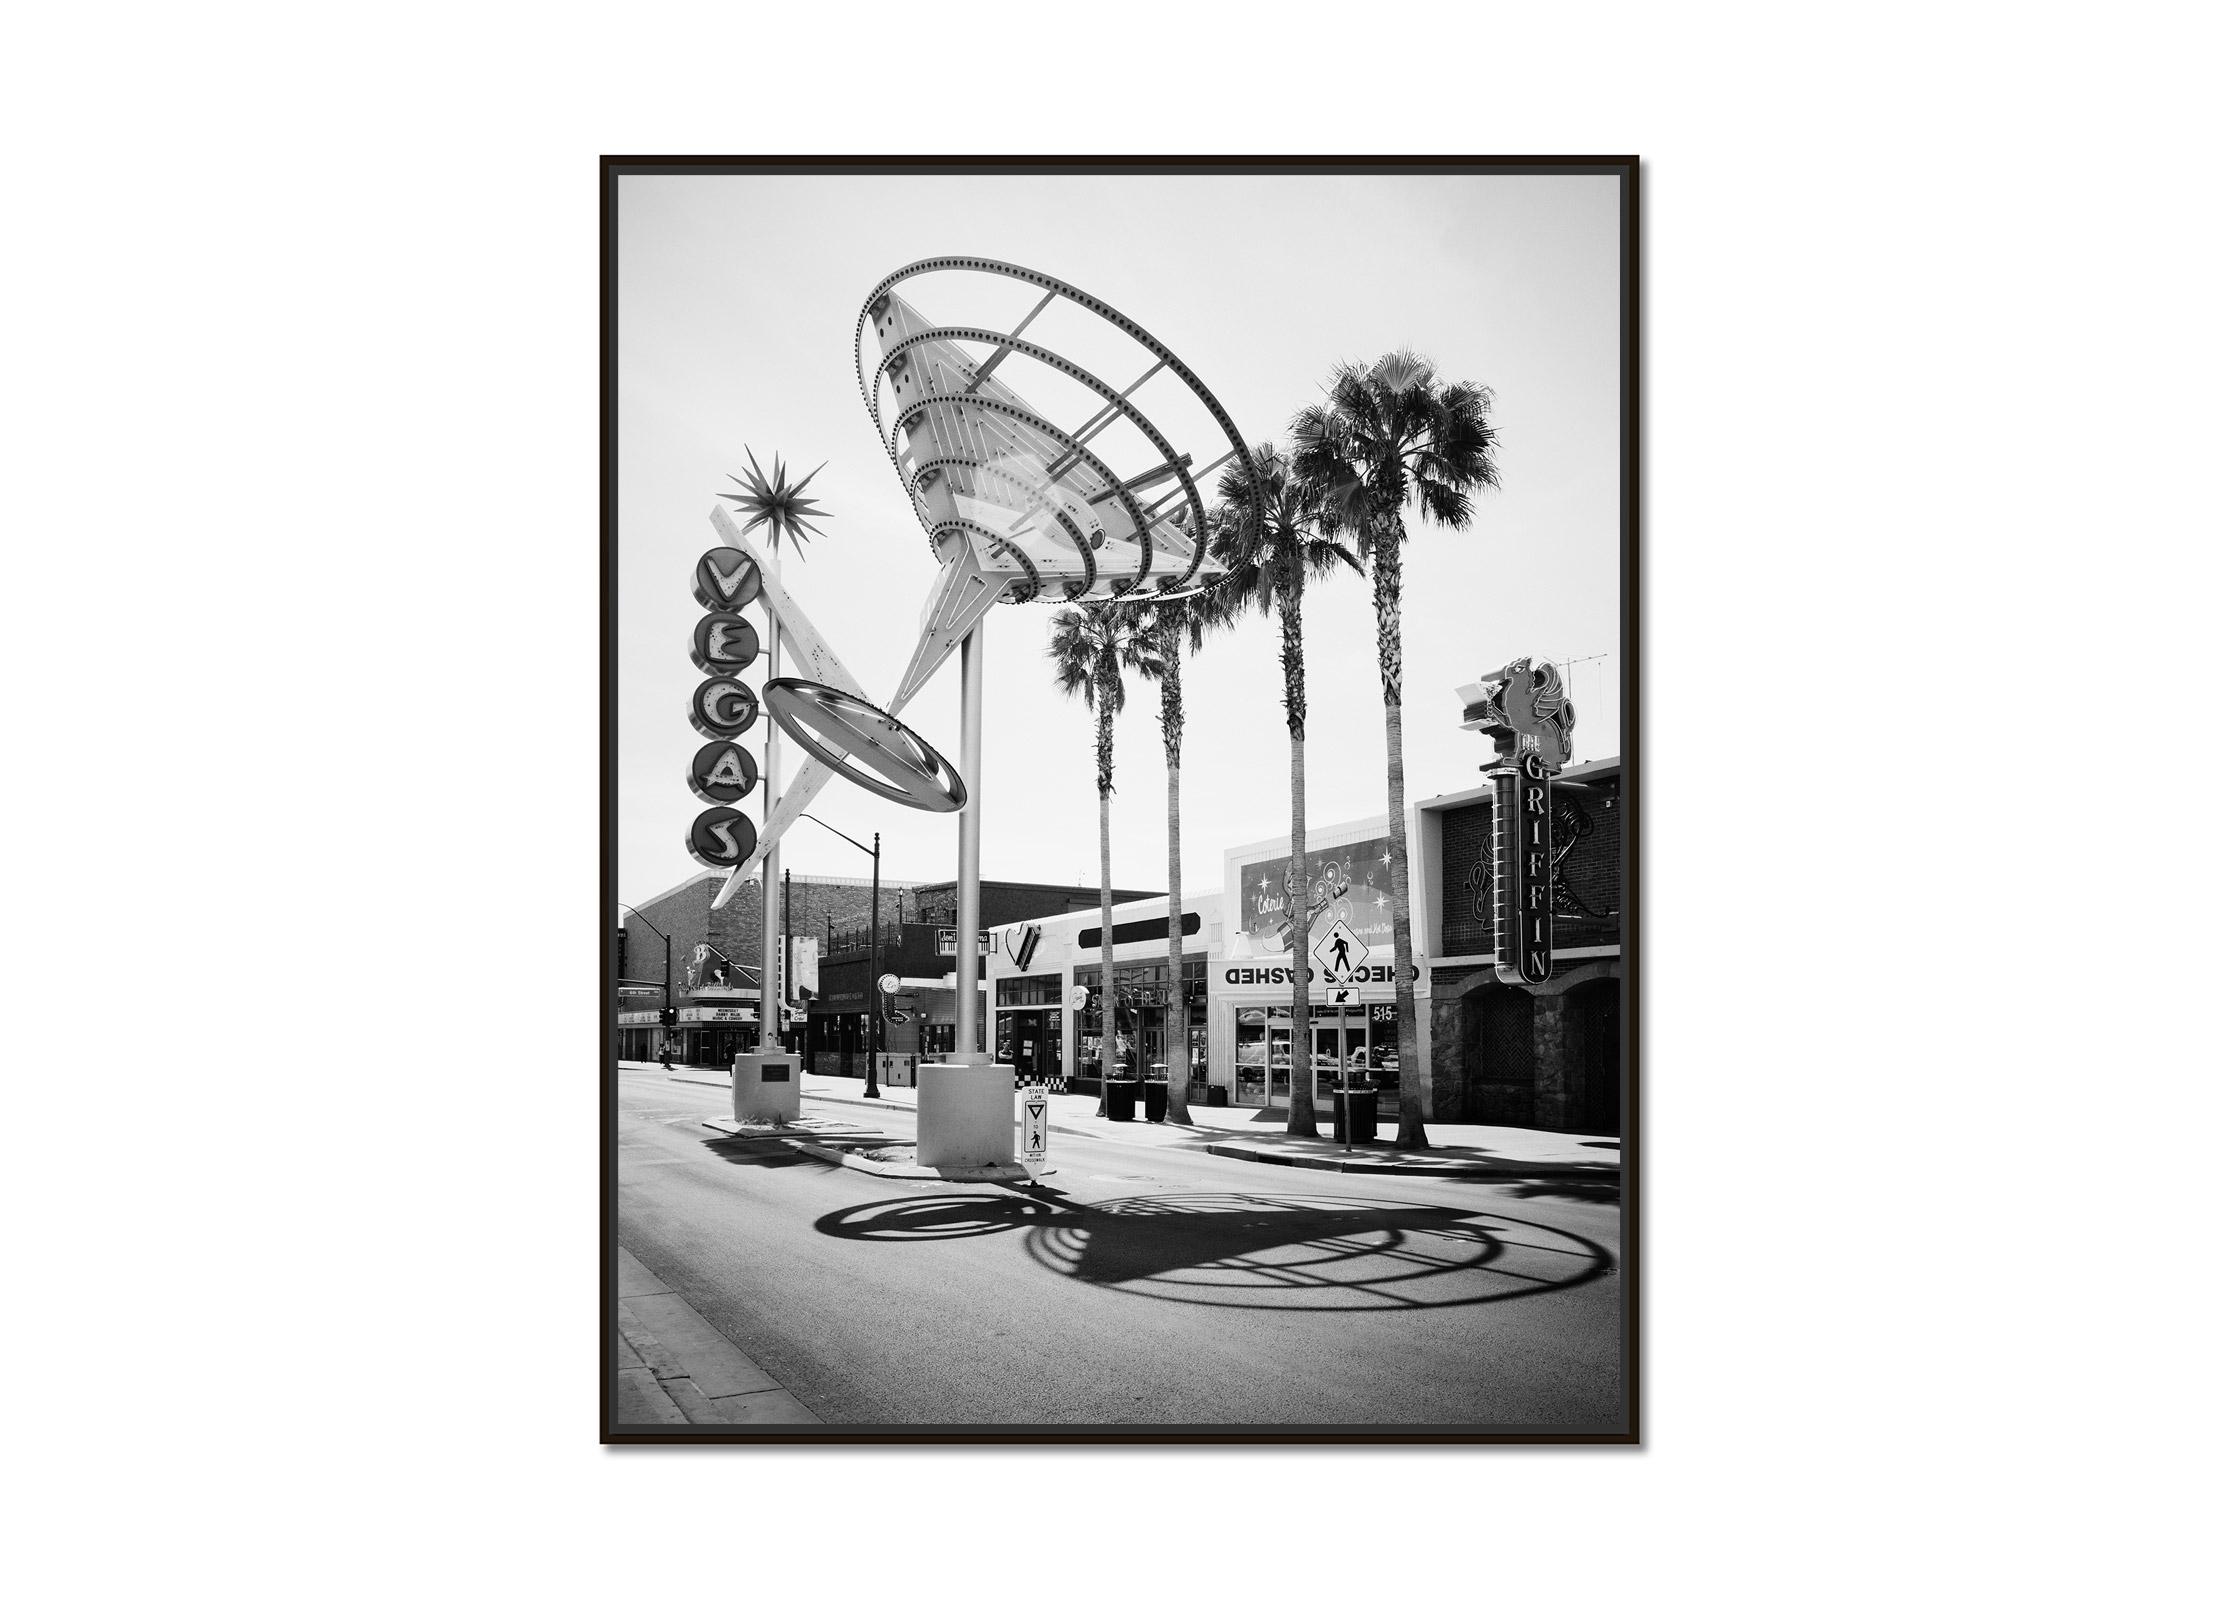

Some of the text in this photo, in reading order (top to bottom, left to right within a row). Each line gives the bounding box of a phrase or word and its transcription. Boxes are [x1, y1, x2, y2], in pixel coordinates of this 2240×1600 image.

[699, 554, 758, 860] VEGAS
[1521, 734, 1541, 752] THE
[1526, 754, 1546, 977] GRIFFIN
[1258, 892, 1284, 915] Coterie
[1323, 965, 1420, 984] HECS
[1373, 1005, 1393, 1021] 515
